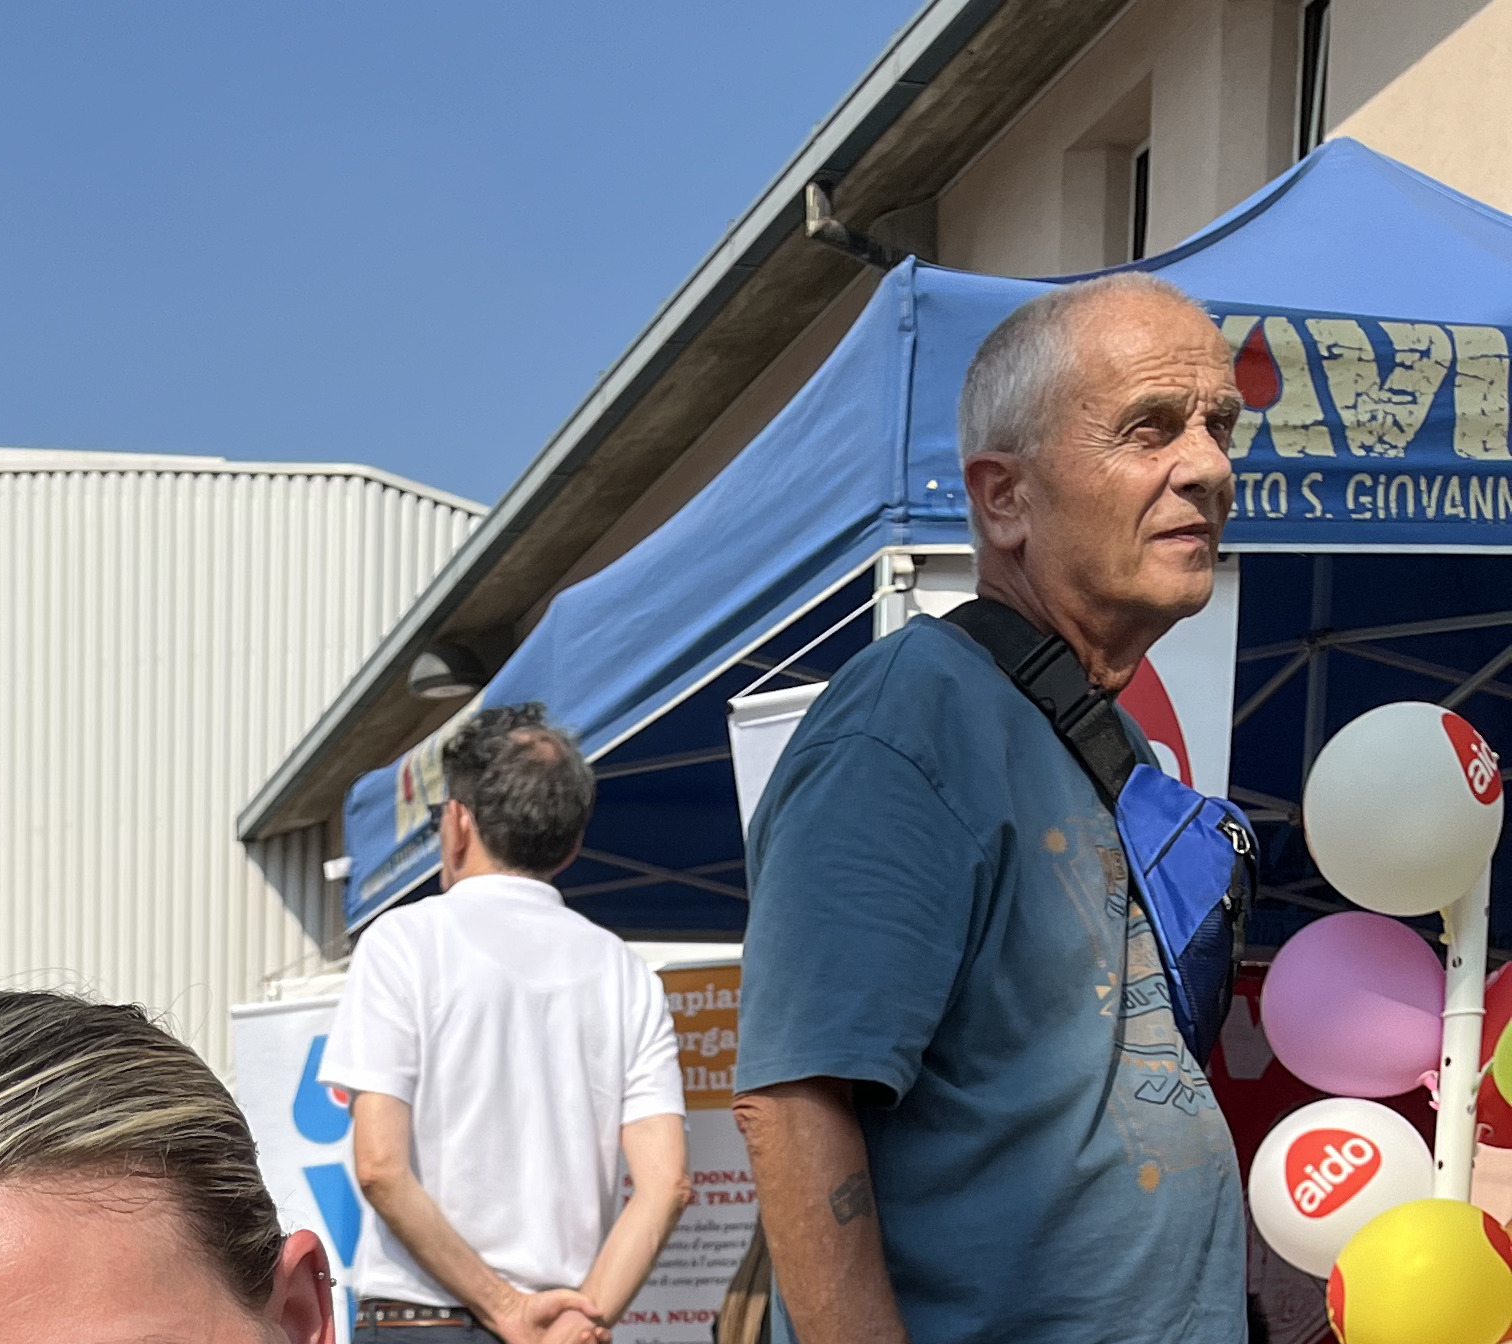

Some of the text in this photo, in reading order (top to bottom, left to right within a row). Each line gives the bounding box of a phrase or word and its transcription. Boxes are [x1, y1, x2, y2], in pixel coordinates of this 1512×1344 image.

[1301, 472, 1334, 520] S.
[667, 983, 741, 1017] apia
[693, 1170, 753, 1185] DONA
[1294, 1138, 1374, 1213] aido
